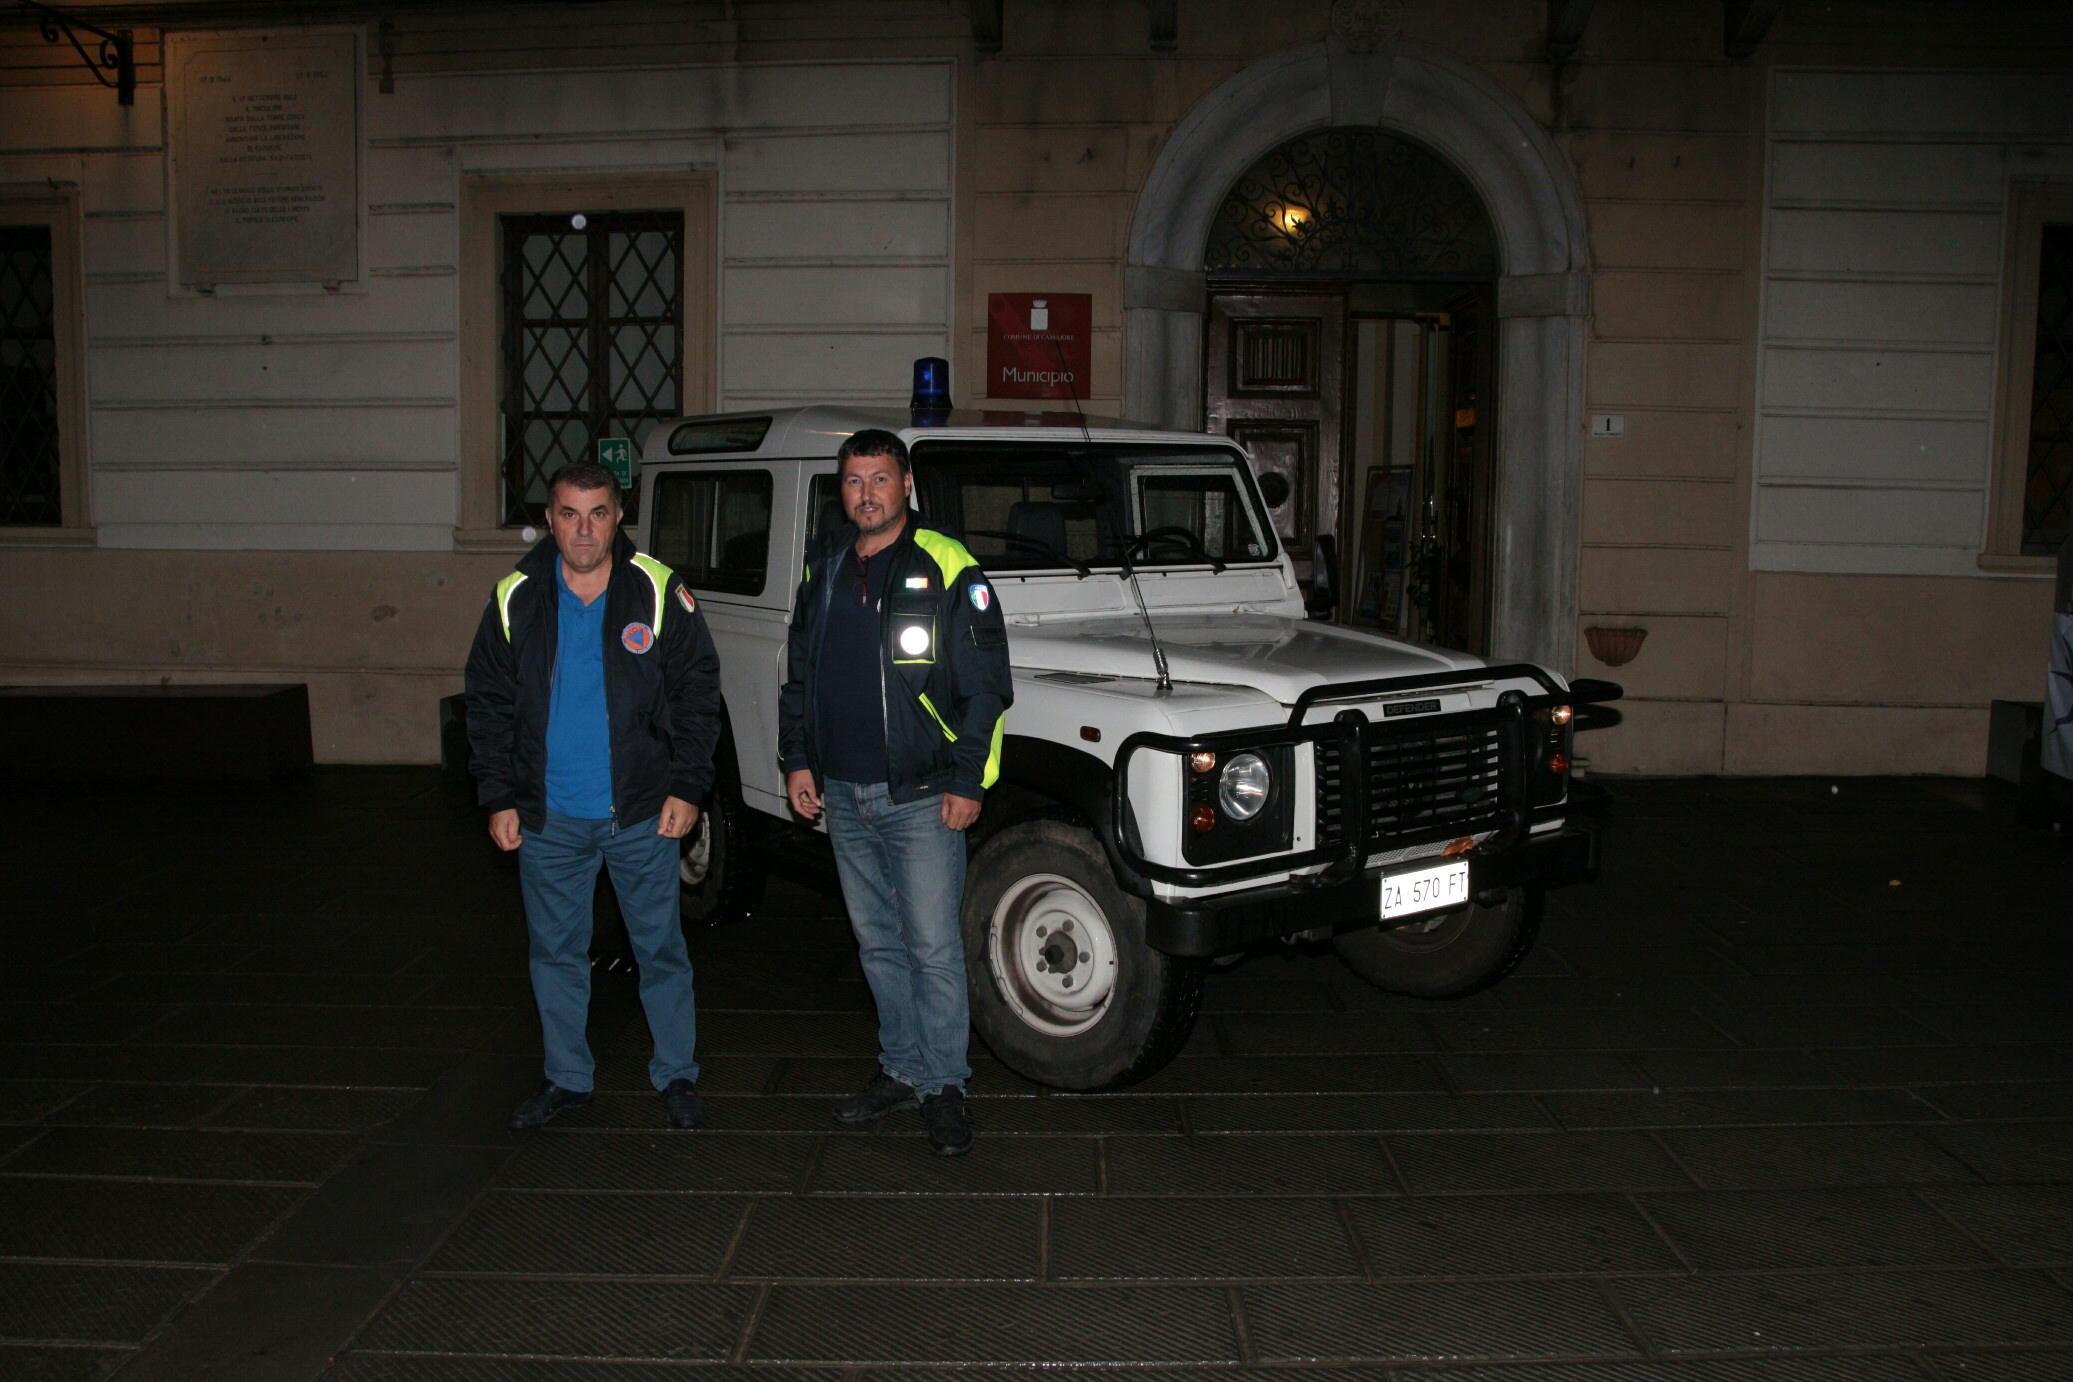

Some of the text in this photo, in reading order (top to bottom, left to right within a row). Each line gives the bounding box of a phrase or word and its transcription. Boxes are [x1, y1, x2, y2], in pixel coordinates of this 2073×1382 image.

[1002, 366, 1075, 388] Municipio
[1605, 417, 1612, 432] 1
[1386, 701, 1438, 715] DEFENDER
[1384, 871, 1467, 910] ZA 570 FT
